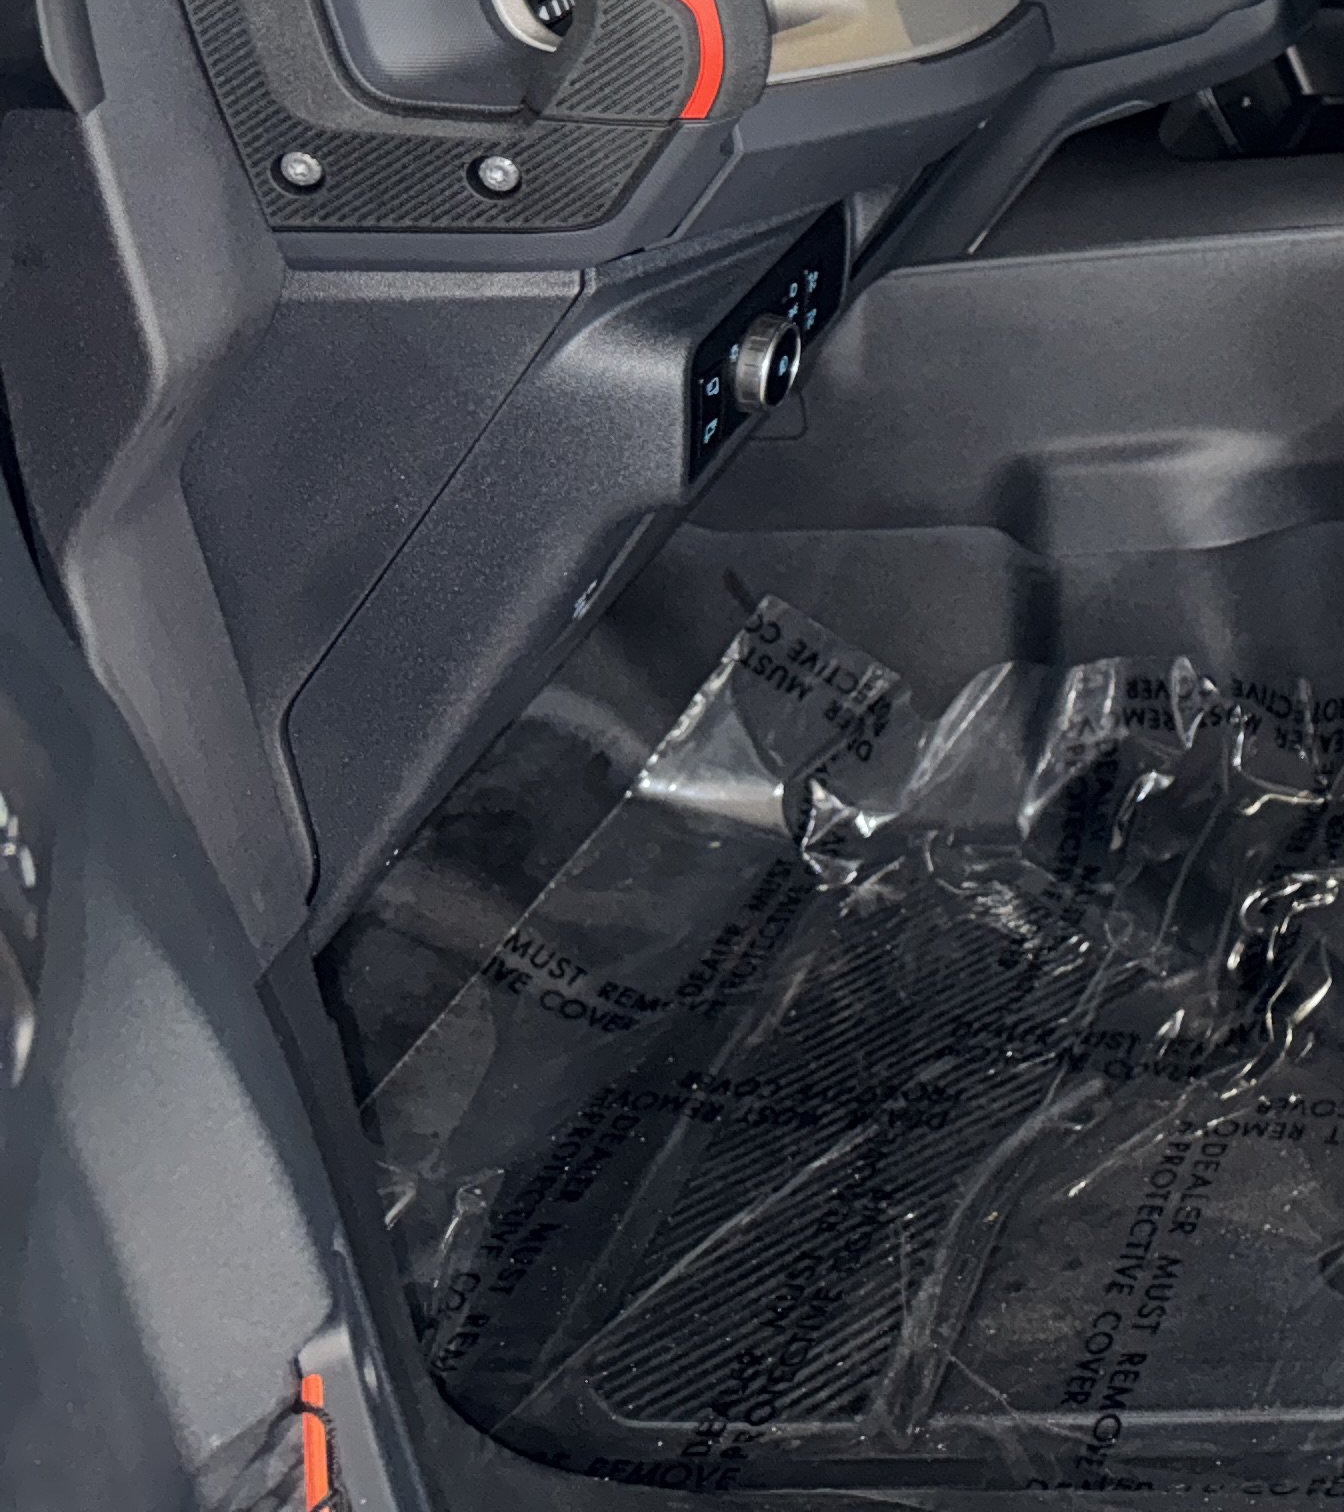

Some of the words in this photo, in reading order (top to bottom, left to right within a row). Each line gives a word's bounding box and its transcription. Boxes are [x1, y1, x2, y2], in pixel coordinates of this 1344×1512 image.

[740, 646, 814, 702] MUST
[503, 929, 589, 987] MUST
[1102, 1139, 1193, 1298] PROTECTIVE
[1168, 1139, 1229, 1238] DEALER
[1131, 1253, 1185, 1337] MUST
[1059, 1308, 1124, 1407] COVER
